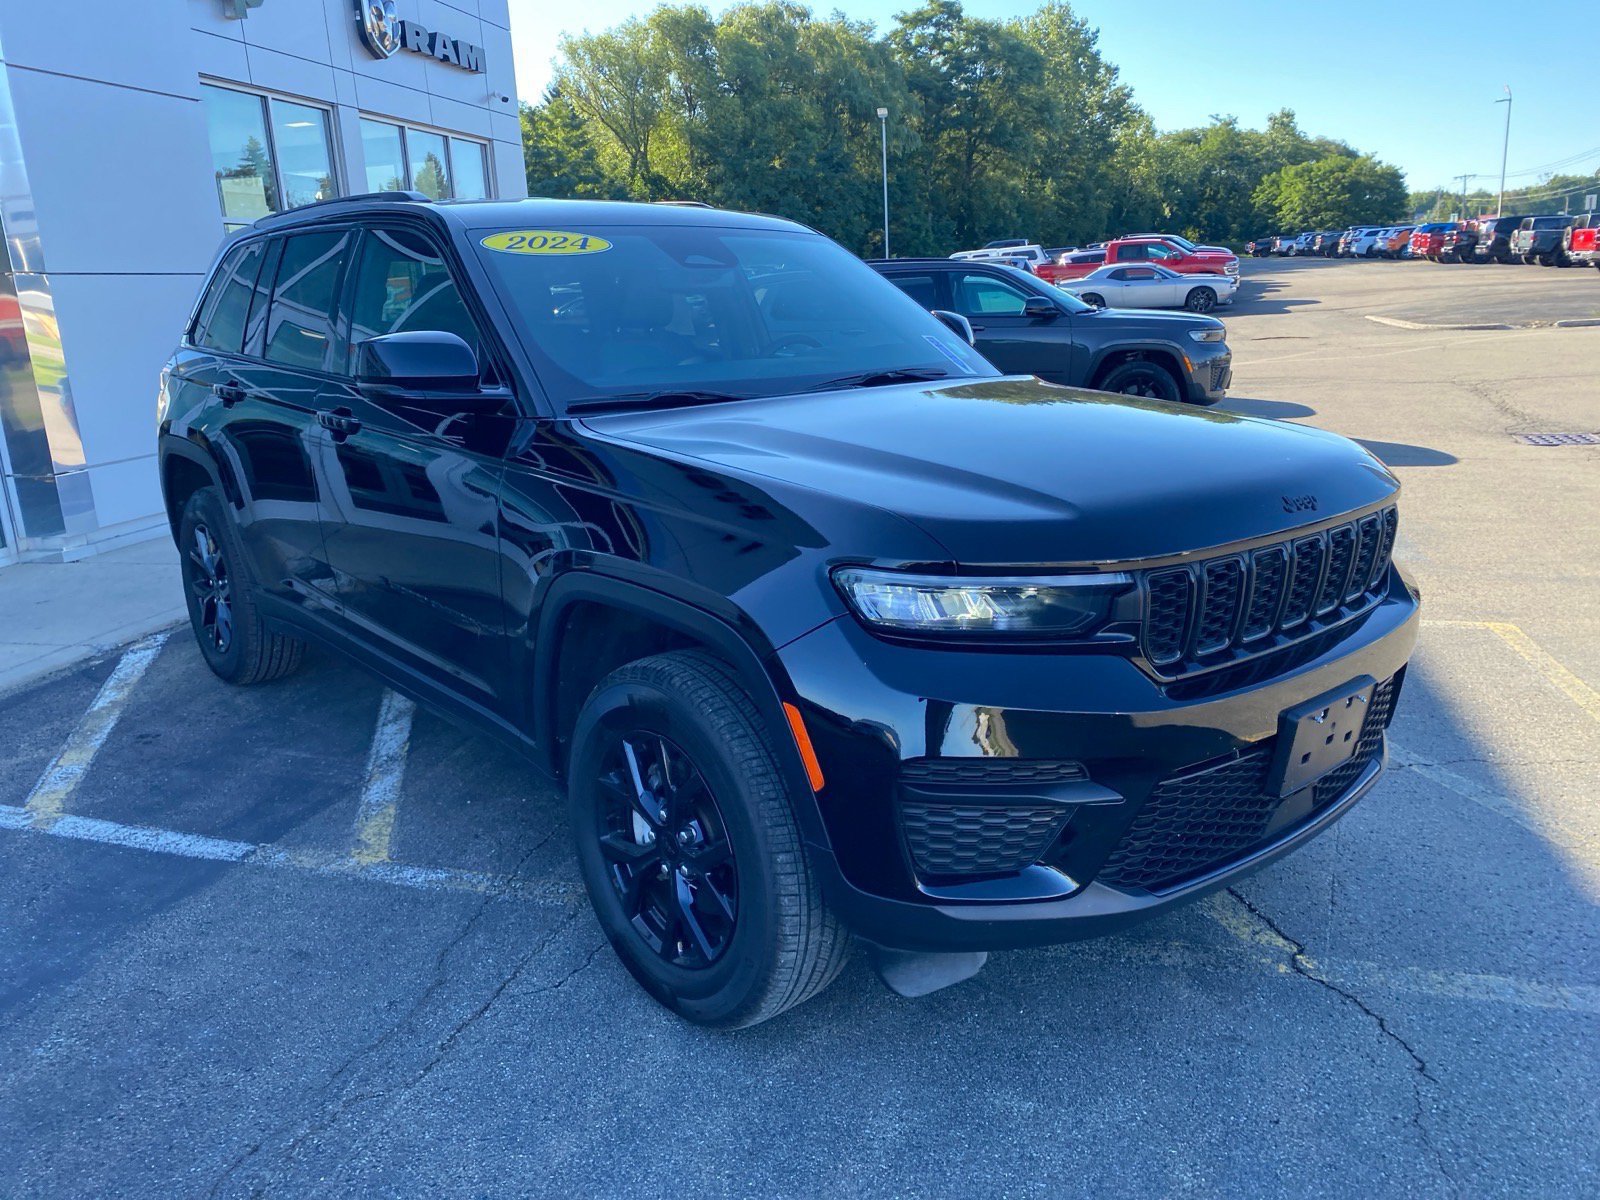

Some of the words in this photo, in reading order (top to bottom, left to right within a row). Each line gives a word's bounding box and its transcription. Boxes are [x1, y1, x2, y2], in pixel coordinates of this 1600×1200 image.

[401, 20, 486, 73] RAM
[505, 235, 591, 250] 2024
[1281, 495, 1318, 513] Jeep
